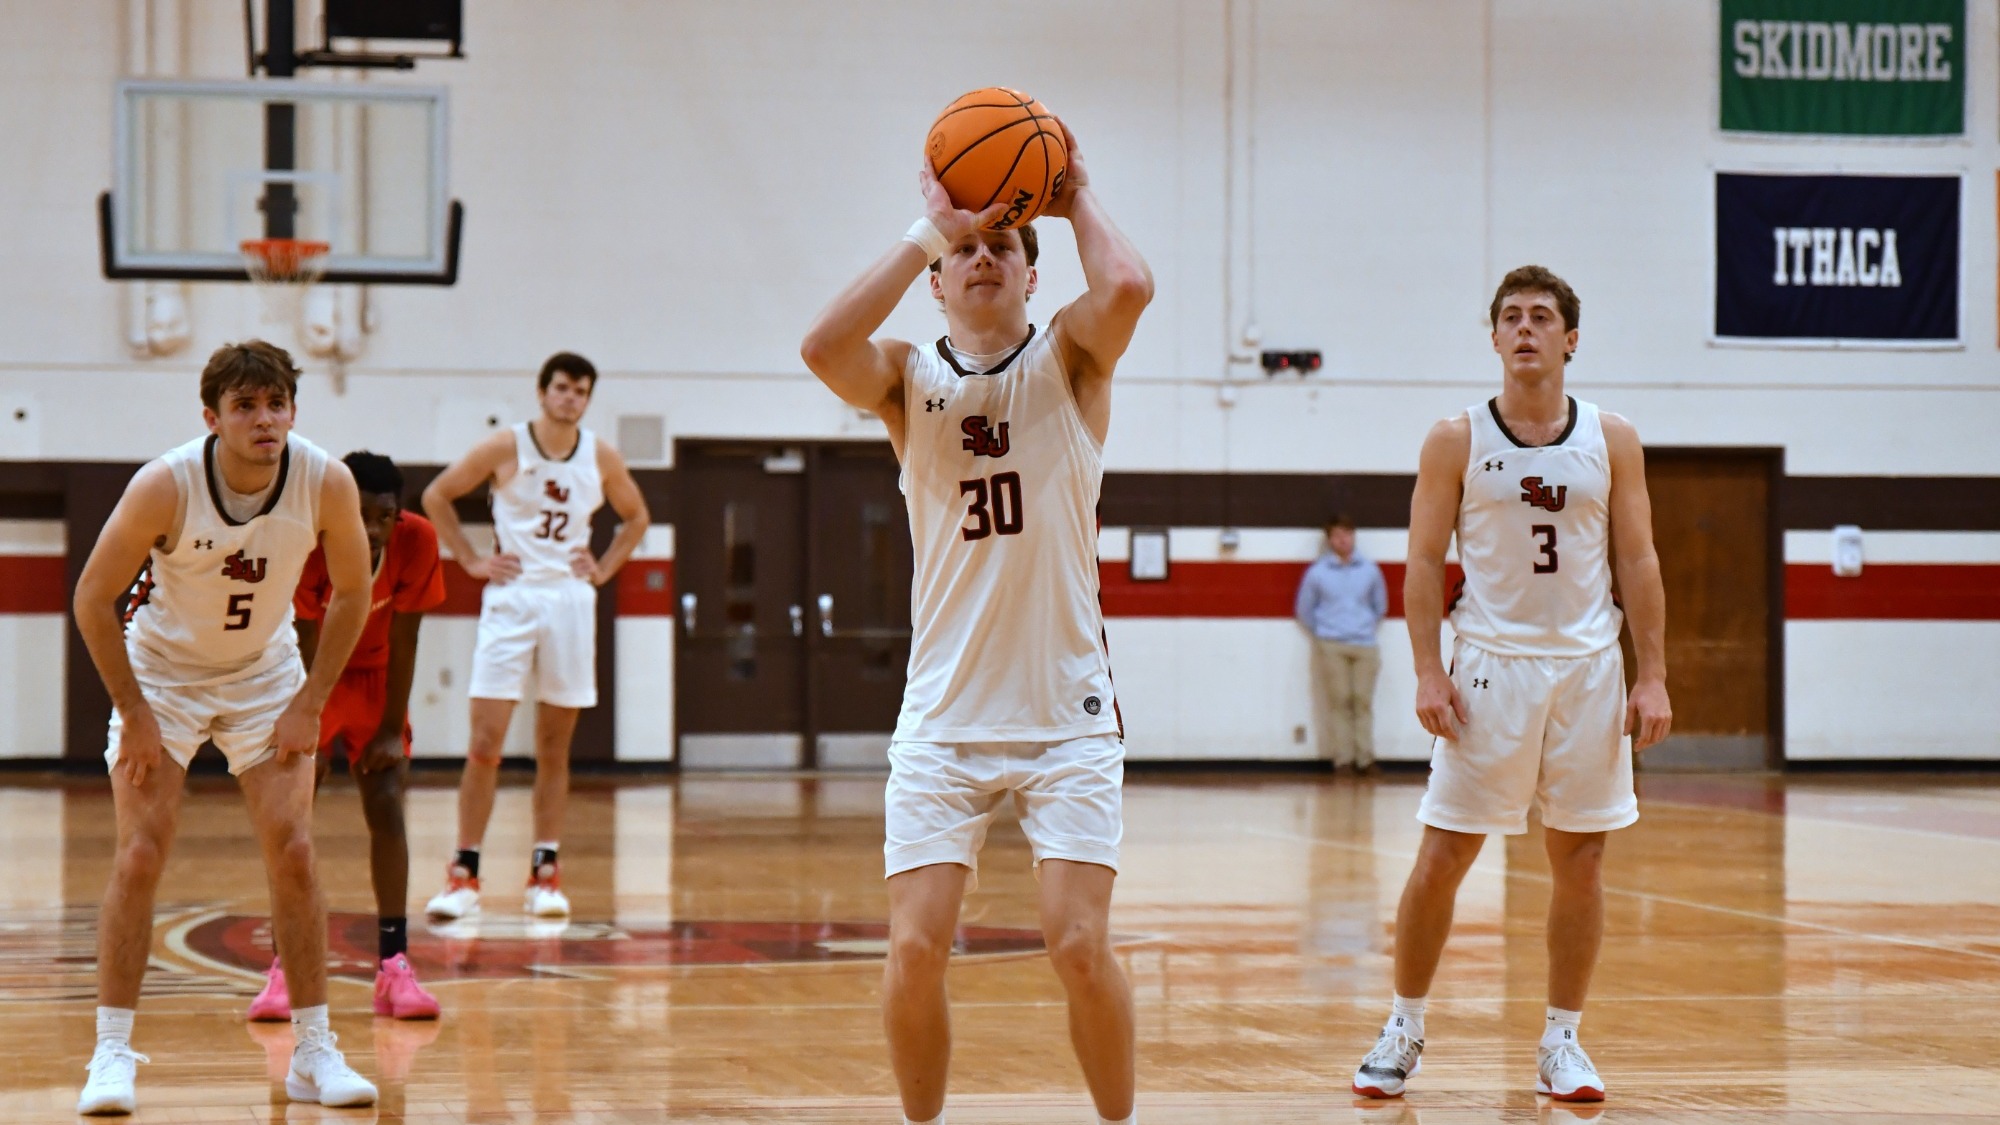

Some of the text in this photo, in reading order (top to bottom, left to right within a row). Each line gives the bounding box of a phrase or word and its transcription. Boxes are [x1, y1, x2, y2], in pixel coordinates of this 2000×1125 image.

[1734, 19, 1952, 81] SKIDMORE
[1773, 227, 1901, 287] ITHACA
[535, 510, 568, 542] 32
[959, 471, 1023, 541] 30
[1532, 525, 1558, 573] 3
[224, 593, 254, 631] 5
